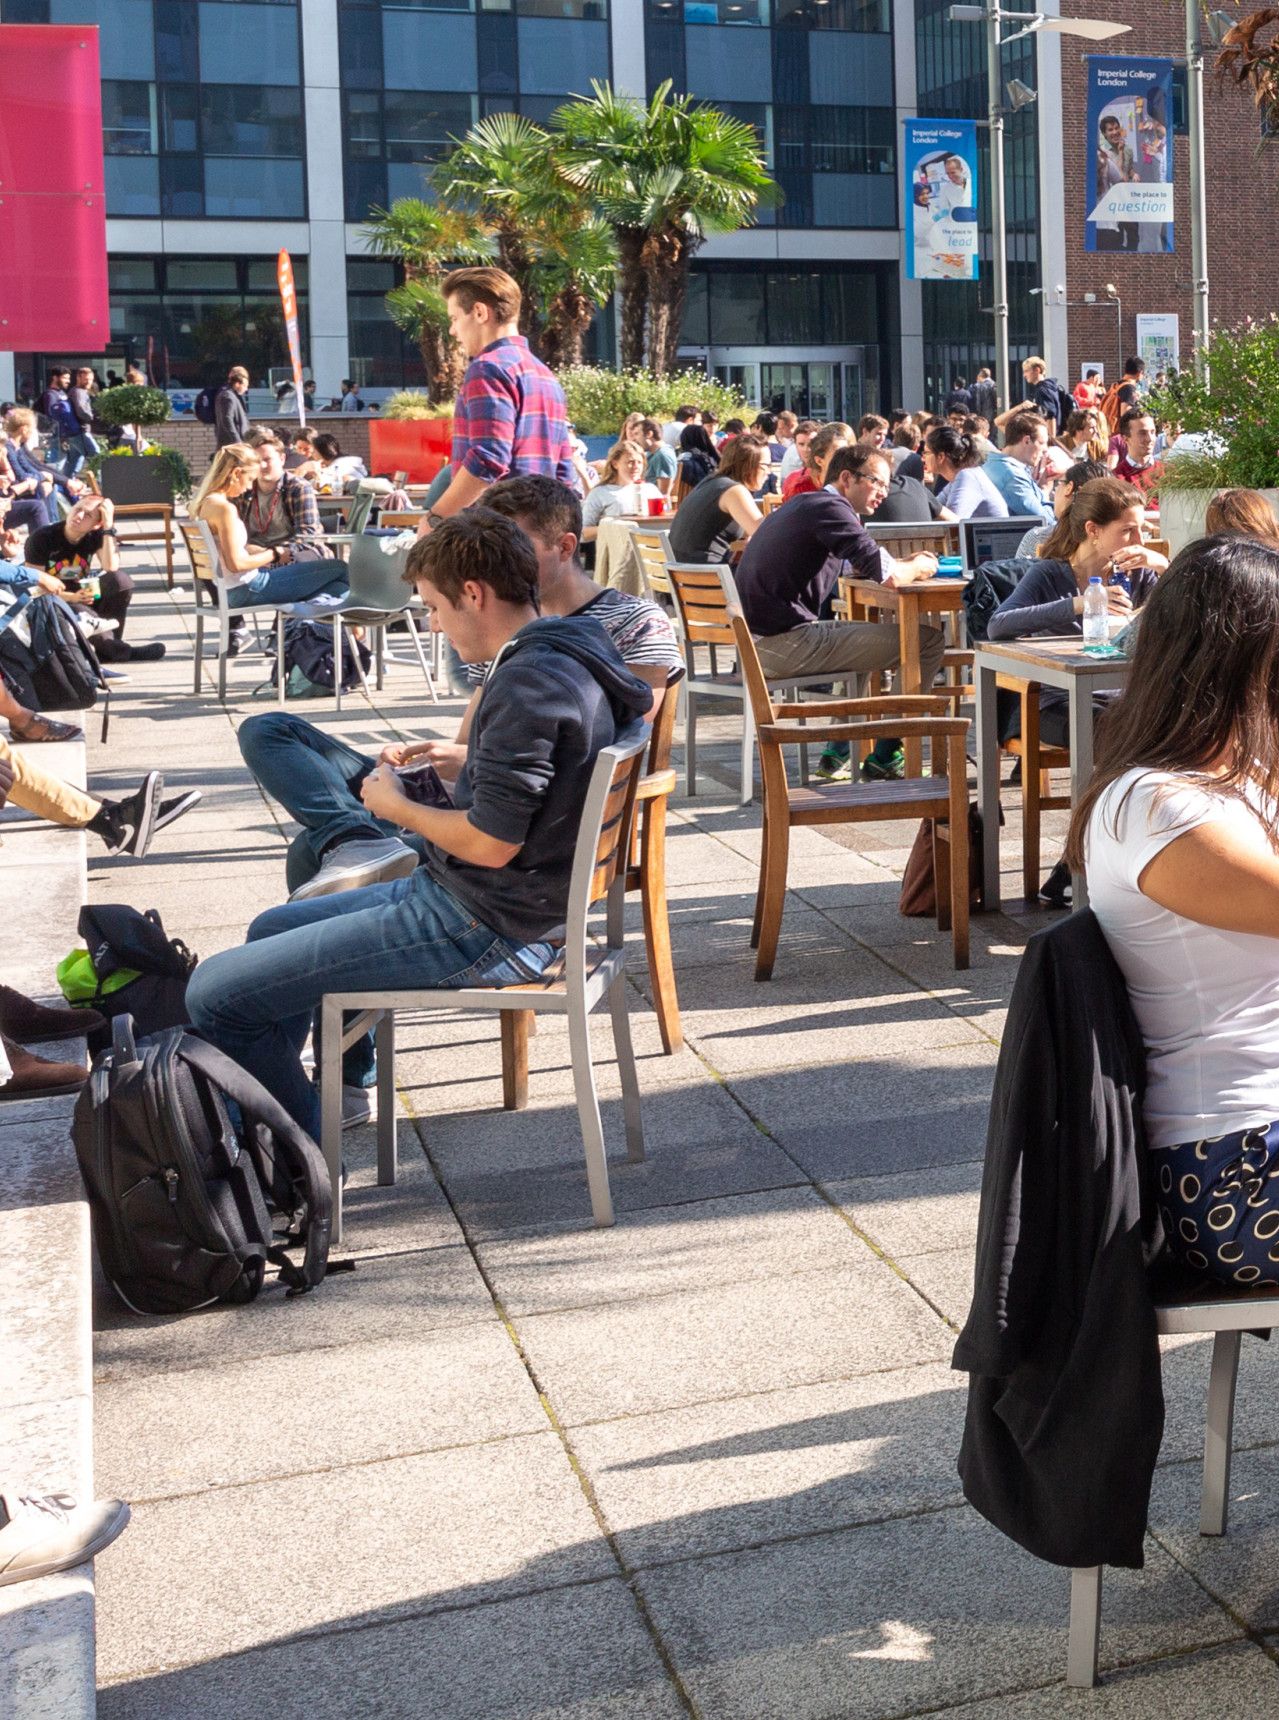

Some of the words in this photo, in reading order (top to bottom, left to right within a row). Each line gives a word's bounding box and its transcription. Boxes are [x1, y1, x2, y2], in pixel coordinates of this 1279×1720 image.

[1097, 69, 1128, 78] Imperial
[1129, 70, 1157, 80] College
[1097, 78, 1128, 86] London
[1142, 191, 1160, 199] place
[1108, 200, 1167, 213] question
[948, 236, 973, 246] lead
